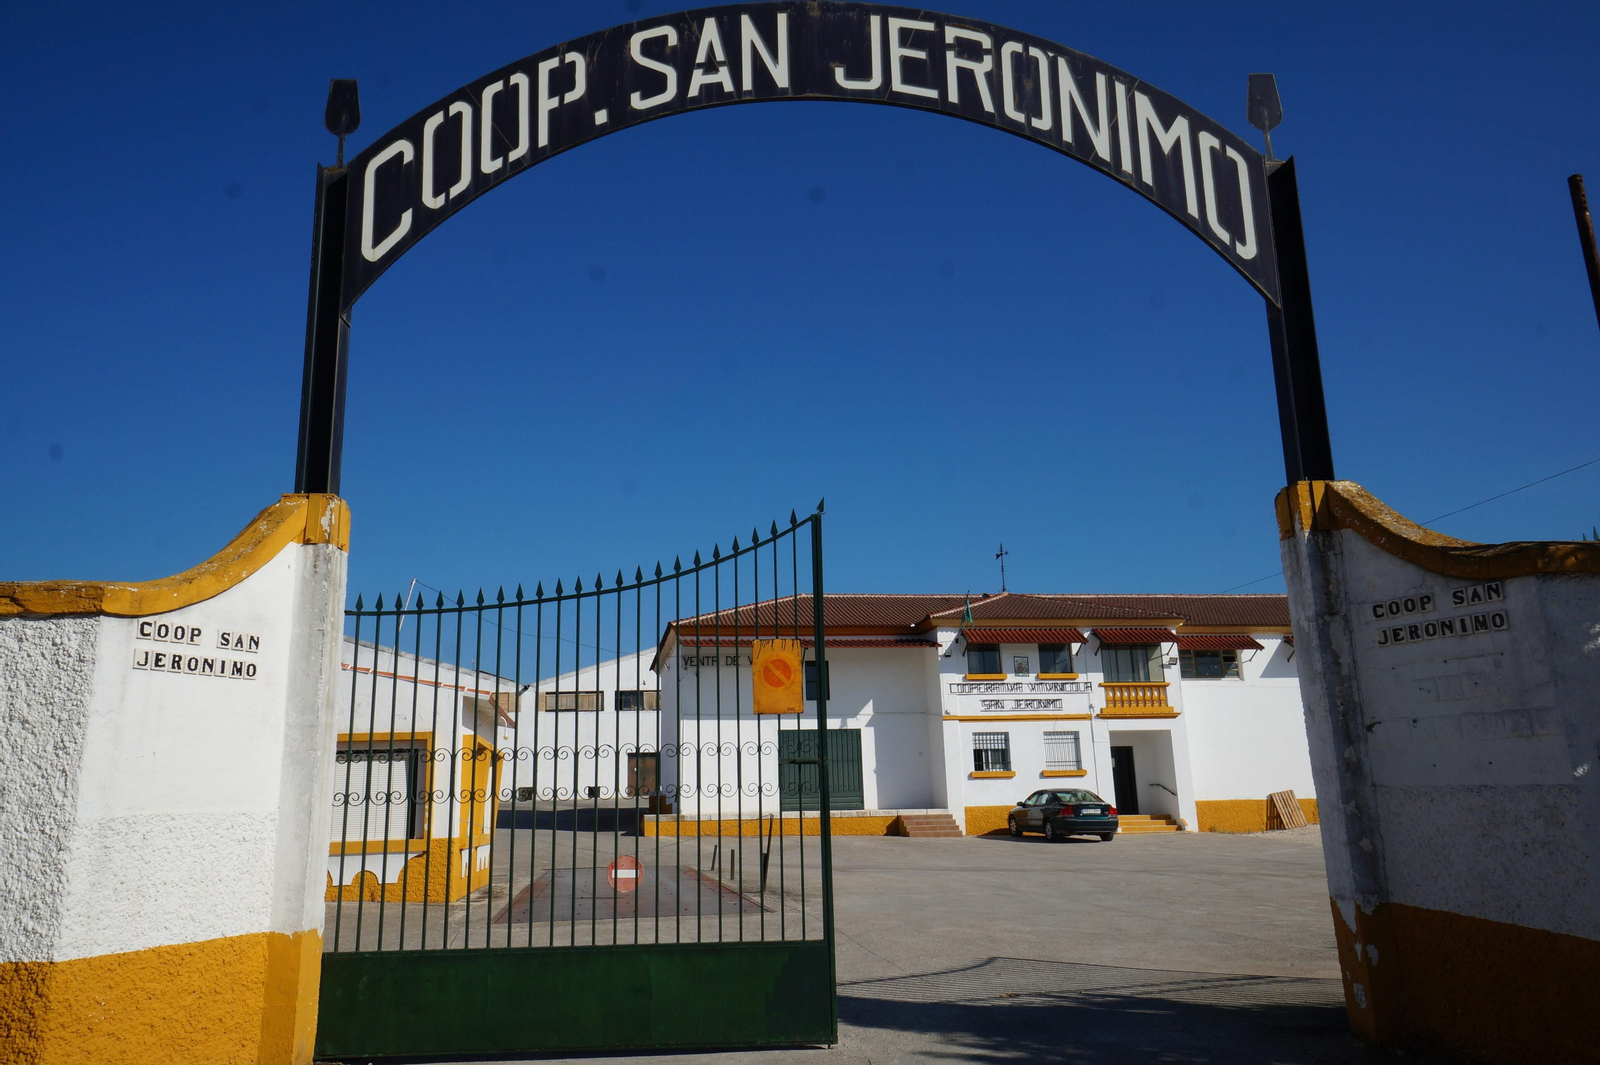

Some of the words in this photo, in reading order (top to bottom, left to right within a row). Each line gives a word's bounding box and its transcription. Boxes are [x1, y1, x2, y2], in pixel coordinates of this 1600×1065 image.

[361, 52, 608, 262] COOP.
[630, 13, 789, 110] SAN
[835, 14, 1257, 260] JERONIMO
[1372, 595, 1432, 618] COOP
[1452, 583, 1501, 606] SAN
[139, 621, 202, 643] COOP
[220, 632, 260, 650] SAN
[1377, 613, 1505, 645] JERONIMO
[136, 651, 257, 678] JERONIMO
[725, 656, 741, 666] DE
[950, 682, 1023, 694] COOPERATIVA
[981, 699, 1005, 710] SAN
[1010, 698, 1063, 709] JERONIMO
